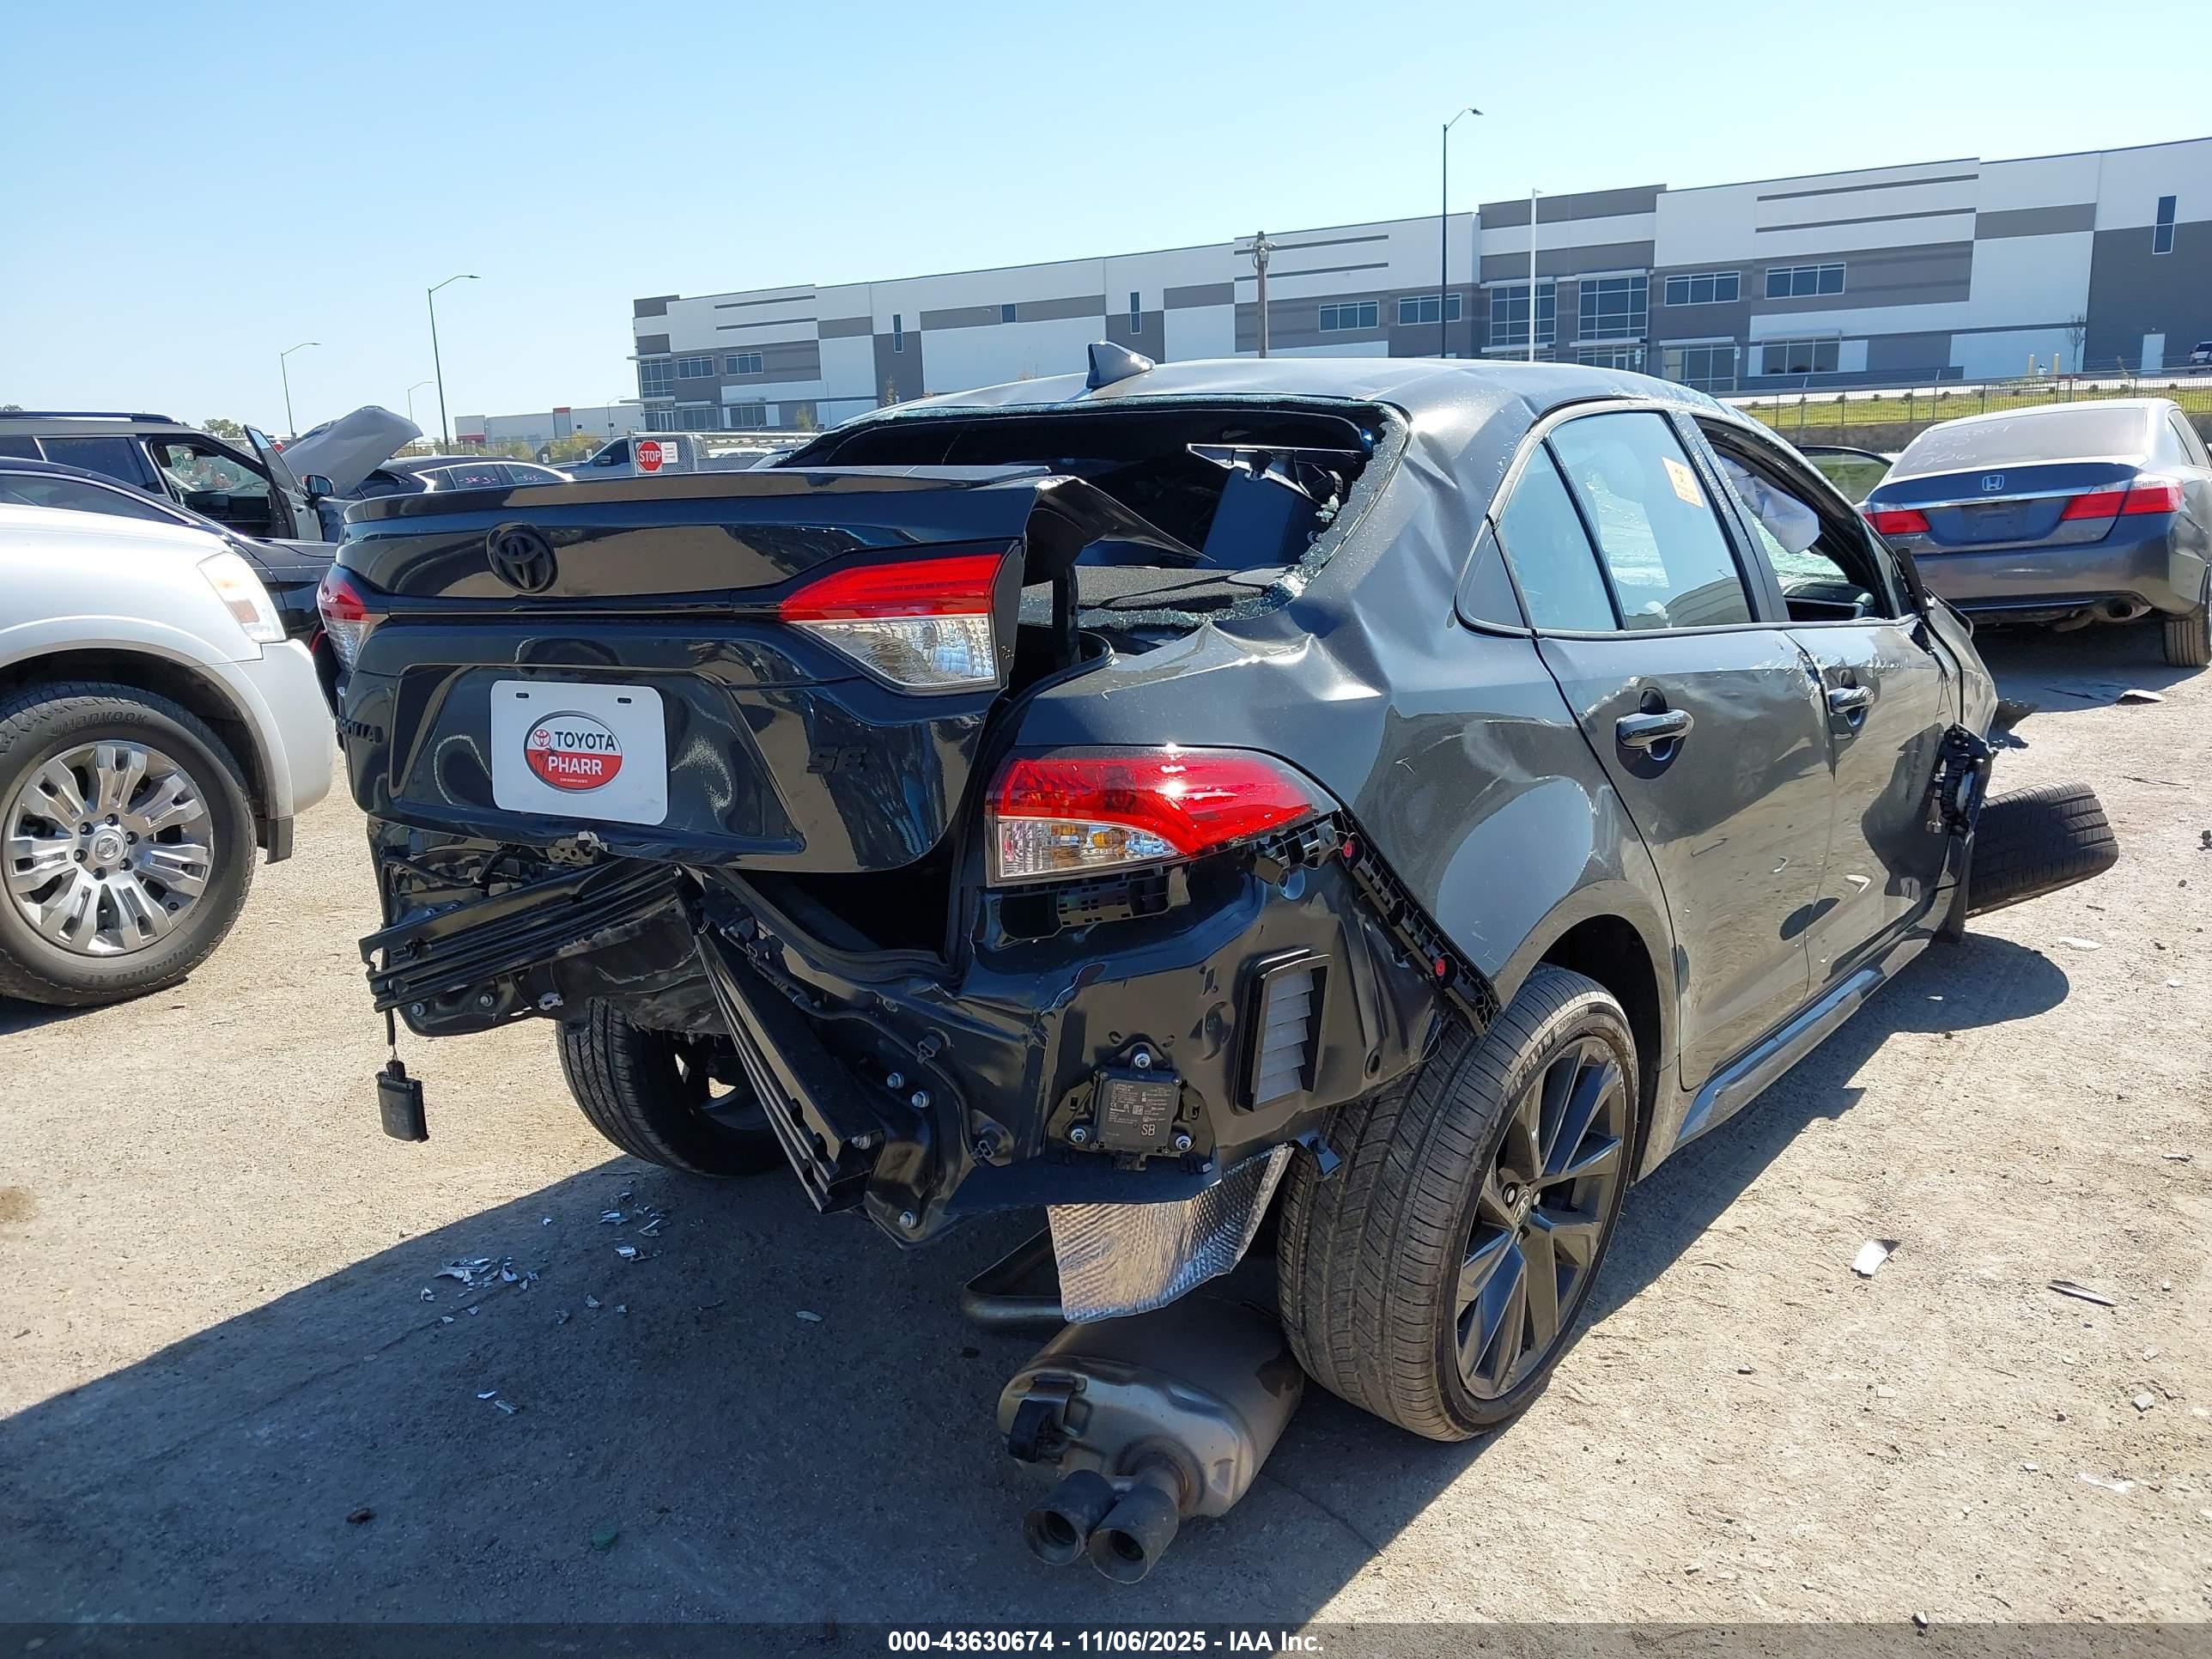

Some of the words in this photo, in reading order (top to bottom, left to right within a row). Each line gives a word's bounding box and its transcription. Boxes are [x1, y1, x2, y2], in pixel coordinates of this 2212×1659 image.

[639, 450, 661, 463] STOP
[555, 732, 617, 751] TOYOTA
[548, 756, 603, 776] PHARR
[807, 746, 867, 774] SE
[1140, 1123, 1156, 1136] SB
